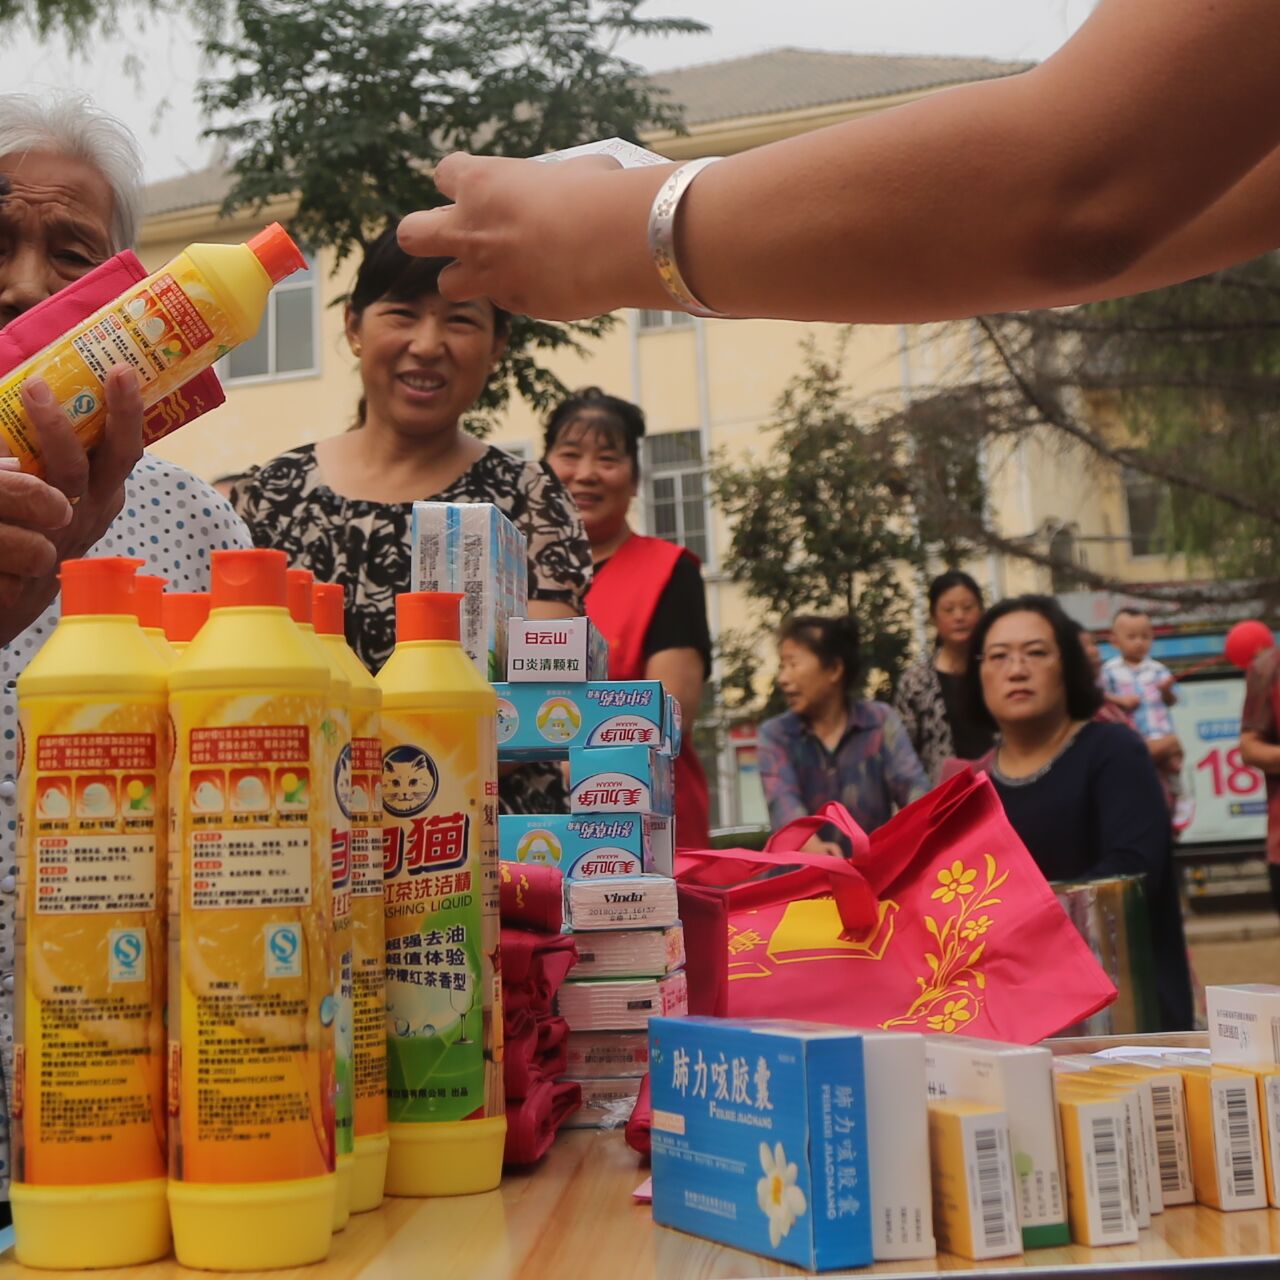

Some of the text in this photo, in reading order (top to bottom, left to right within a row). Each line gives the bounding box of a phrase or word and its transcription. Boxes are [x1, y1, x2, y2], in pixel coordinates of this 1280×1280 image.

[525, 632, 567, 645] 白云山
[513, 658, 579, 671] 口炎清颗粒
[601, 729, 654, 742] 美加净
[578, 788, 642, 805] 美加净
[582, 861, 635, 875] 美加净
[431, 895, 473, 912] LIQUID
[604, 892, 643, 903] Vinda
[385, 925, 465, 951] 超强去油
[385, 948, 466, 967] 超值体验
[385, 968, 466, 992] 柠檬红茶香型
[672, 1048, 773, 1110] 肺力咳胶囊
[835, 1085, 860, 1218] 肺力咳胶囊
